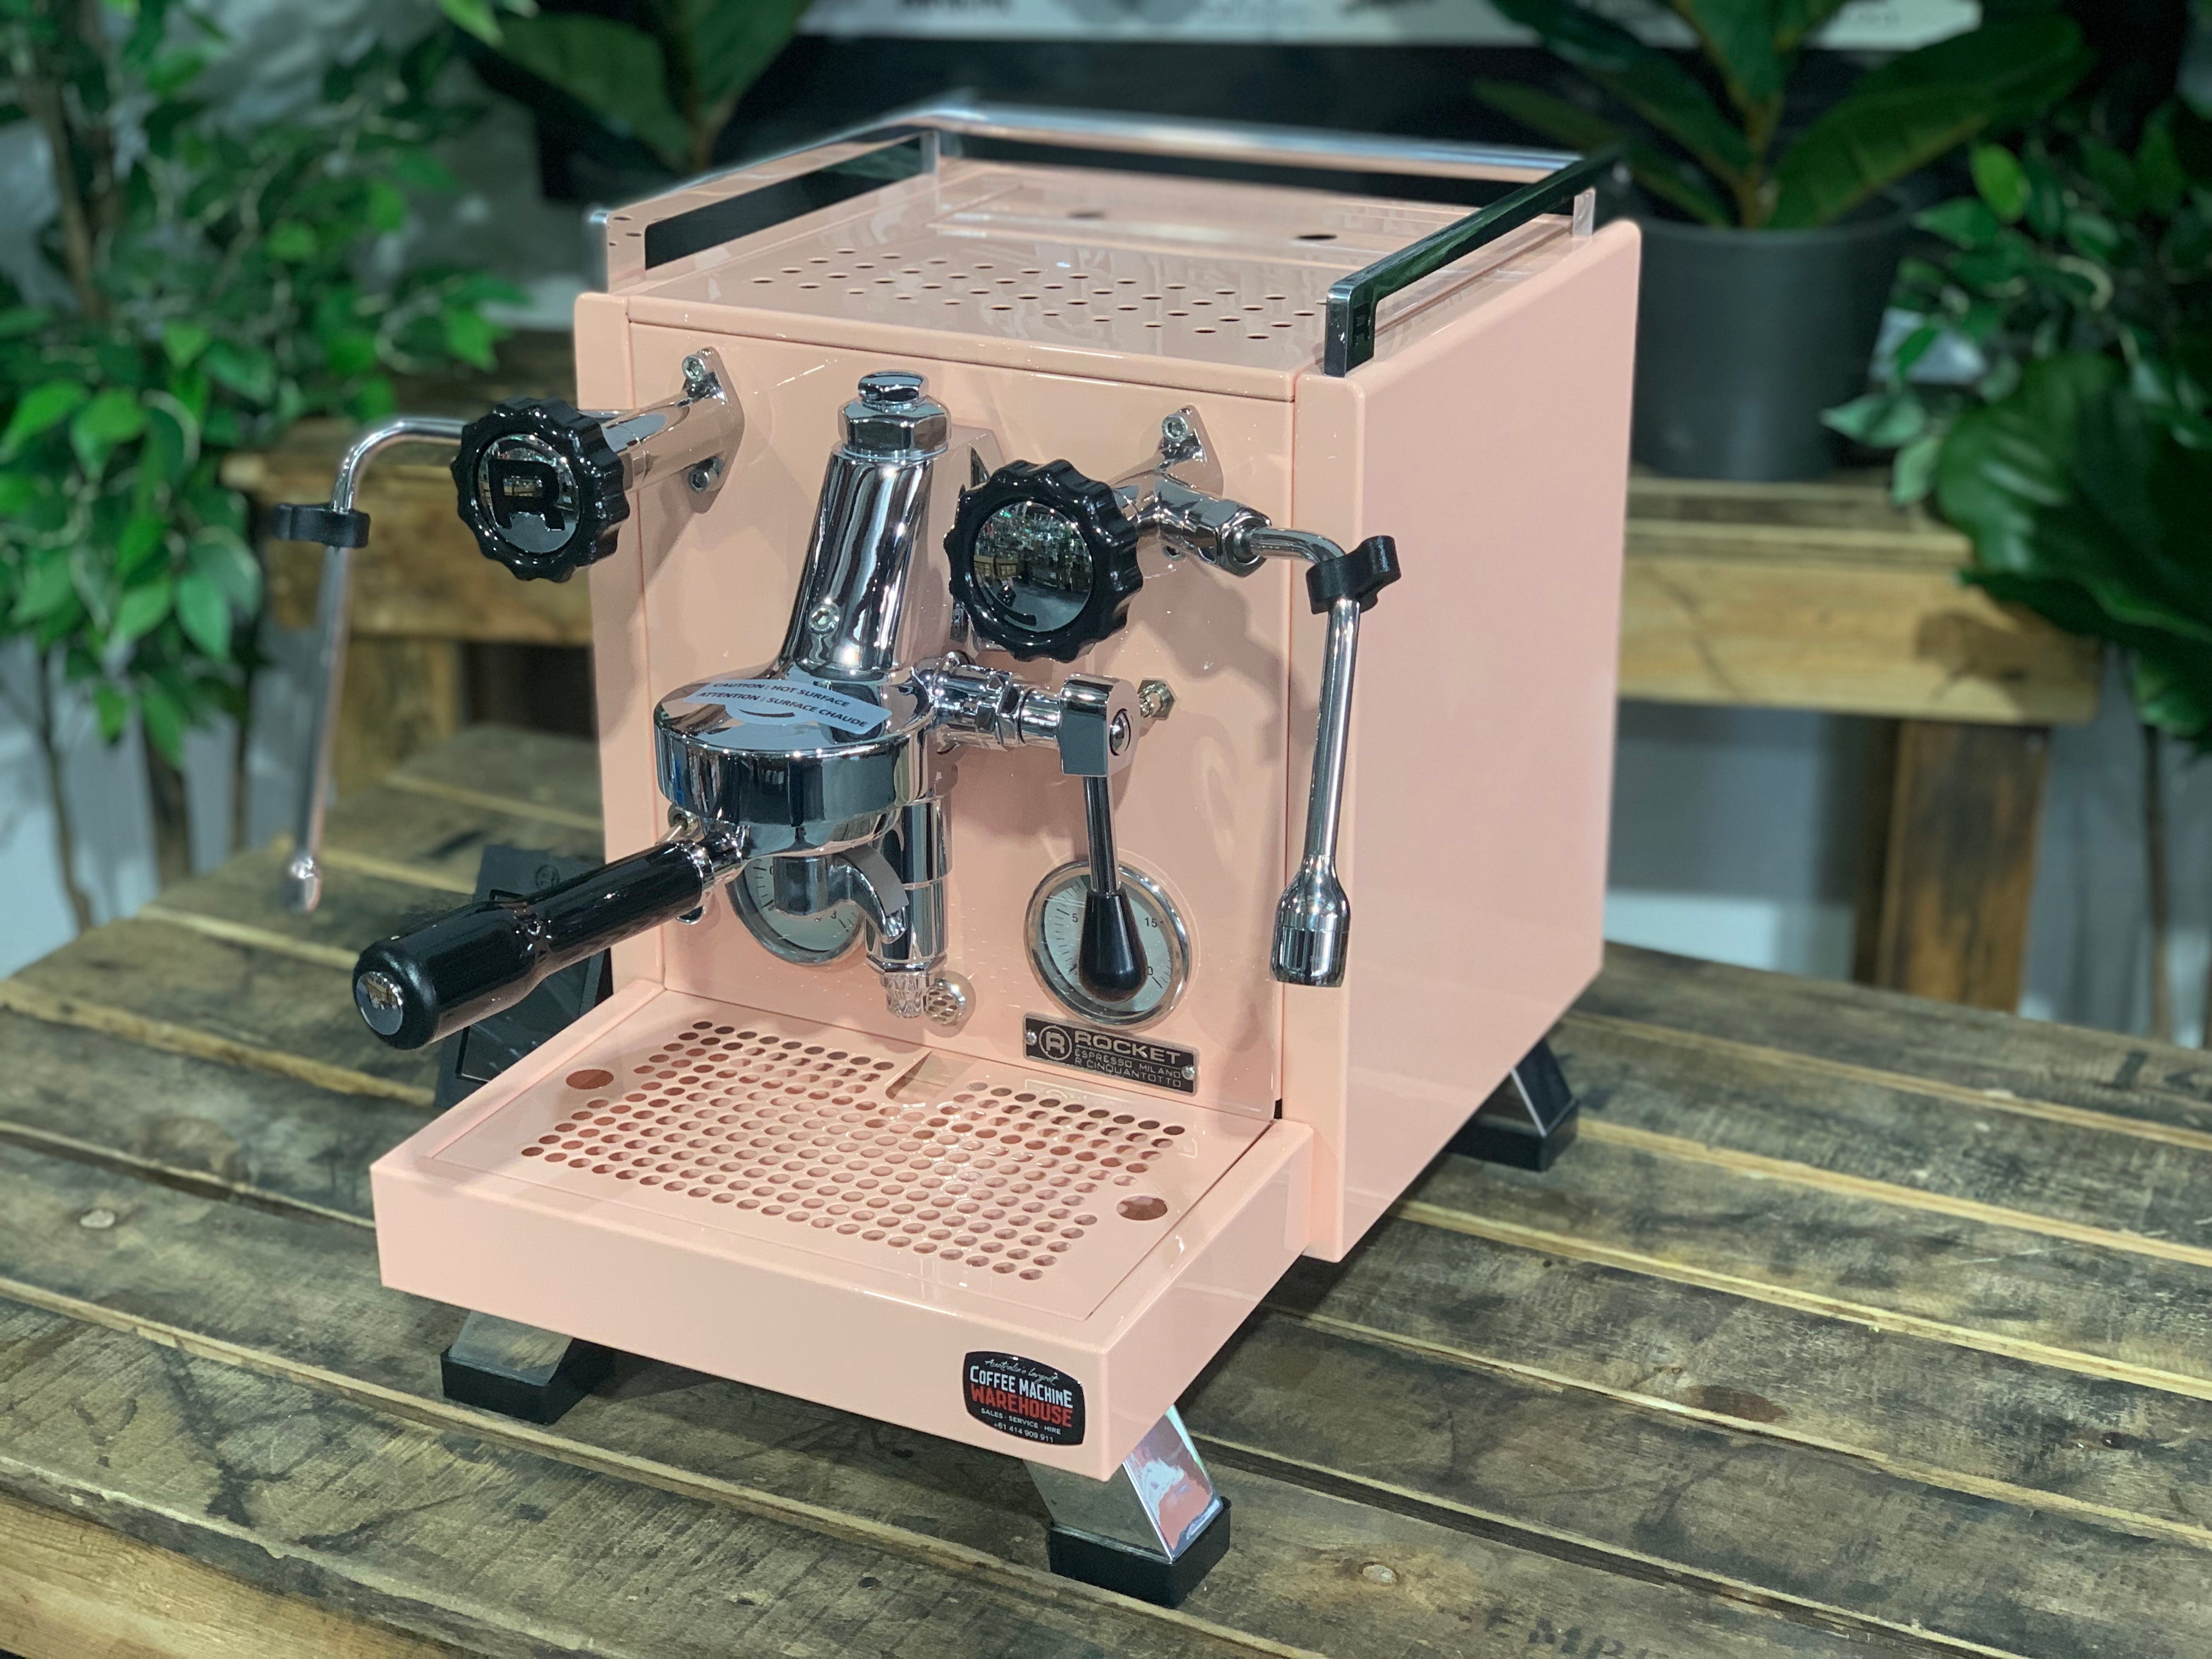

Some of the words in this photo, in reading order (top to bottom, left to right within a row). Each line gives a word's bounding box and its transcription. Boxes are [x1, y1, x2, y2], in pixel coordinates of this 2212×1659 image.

[488, 459, 566, 529] R
[697, 692, 760, 701] ATTENTION
[766, 697, 818, 712] SURFACE
[819, 709, 868, 727] CHAUDE
[797, 689, 850, 707] SURFACE
[1072, 913, 1079, 923] 5
[1144, 917, 1158, 928] 15
[1074, 1030, 1181, 1064] ROCKET
[1075, 1048, 1132, 1068] ESPRESSO
[1139, 1063, 1180, 1079] MILANO
[1075, 1057, 1082, 1066] R
[1086, 1059, 1181, 1087] CINQUANTOTTO
[969, 1365, 1016, 1393] COFFEE
[1019, 1378, 1073, 1408] MACHINE
[970, 1383, 1073, 1427] WAREHOUSE
[981, 1408, 1003, 1419] SALES
[1008, 1415, 1039, 1429] SERVICE
[1044, 1425, 1061, 1435] HIRE
[994, 1421, 1007, 1430] +61
[1009, 1426, 1023, 1434] 414
[1024, 1430, 1039, 1438] 909
[1040, 1434, 1053, 1443] 911
